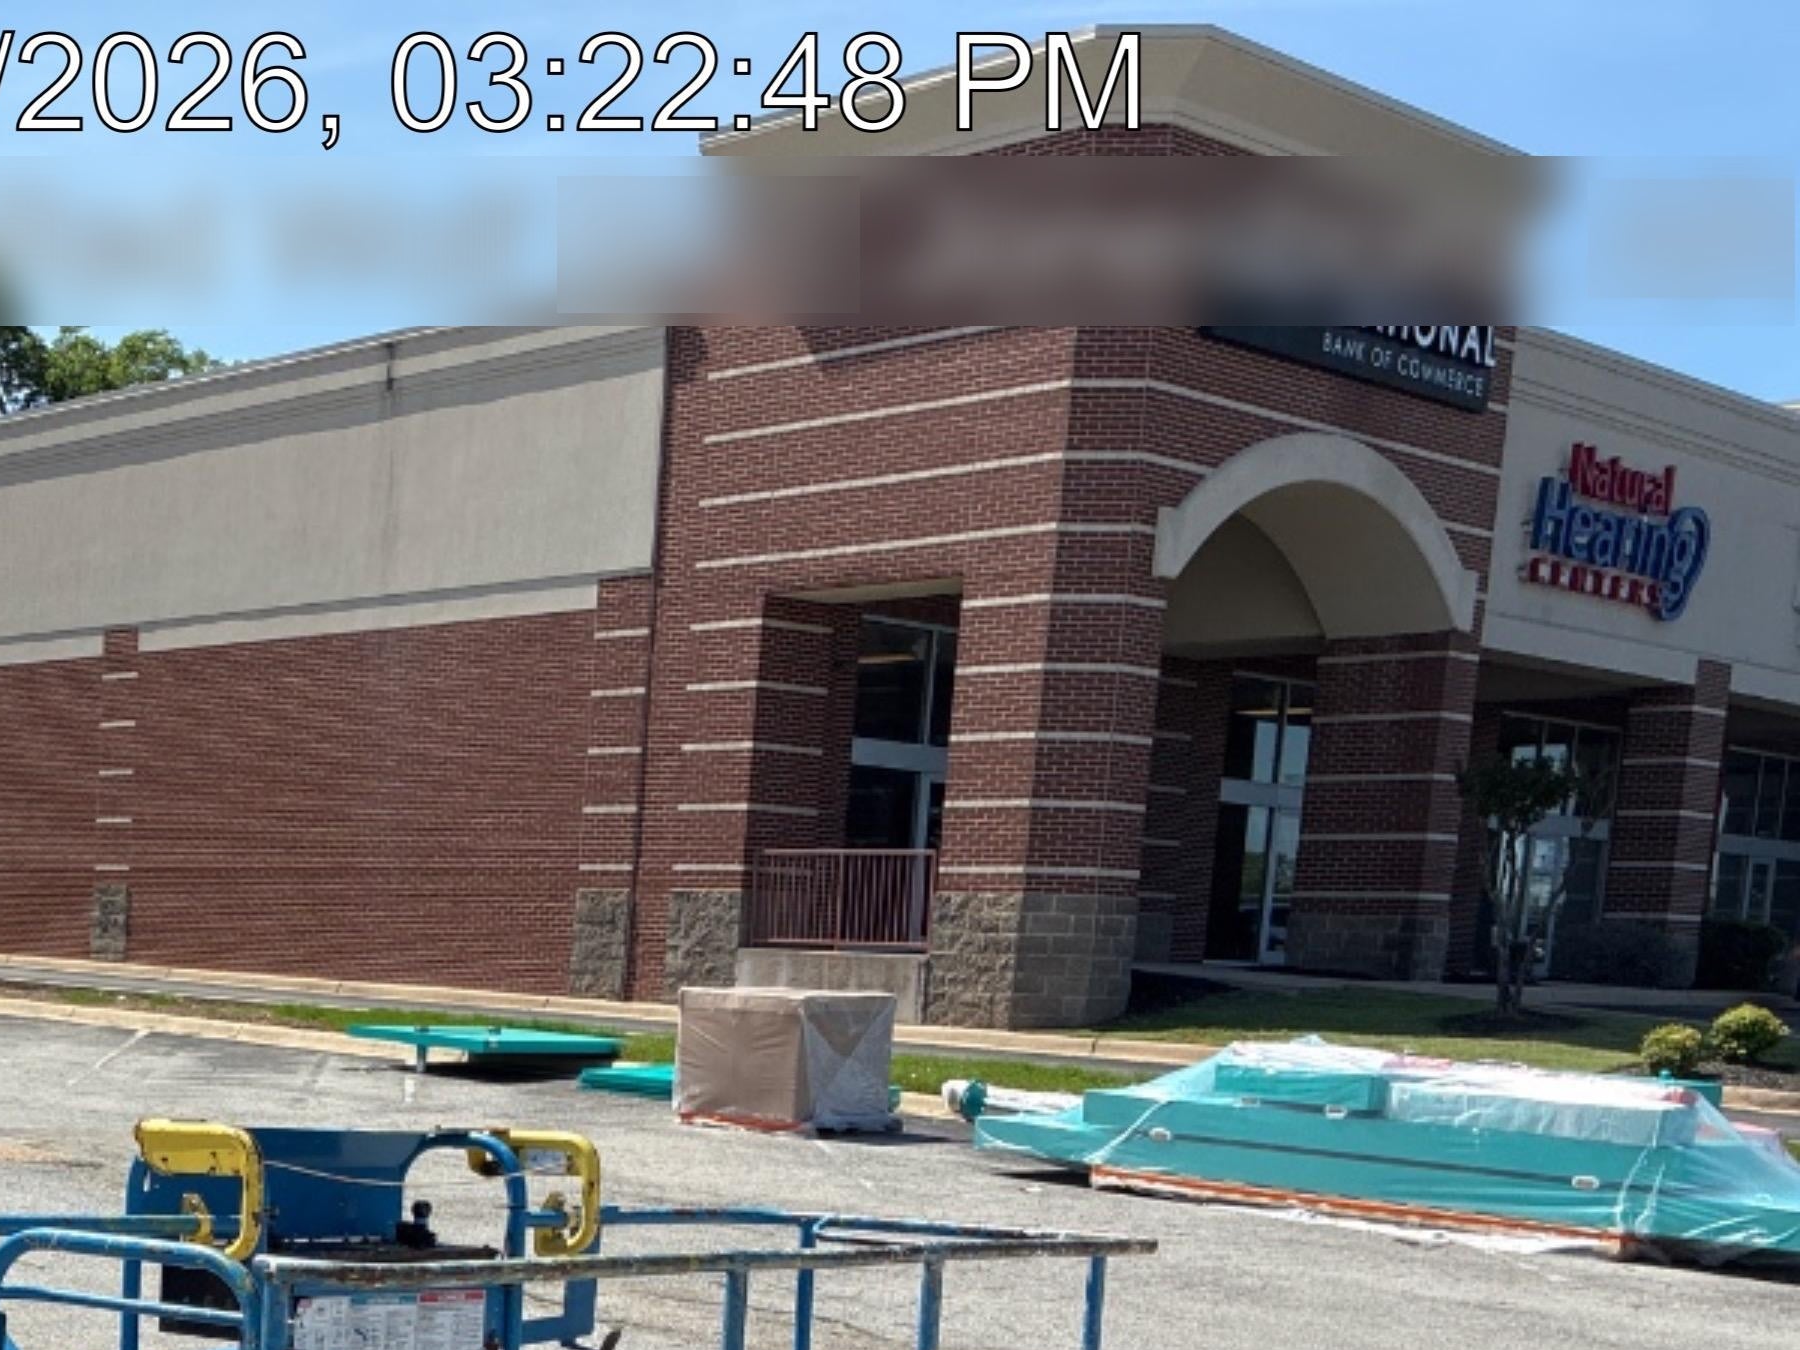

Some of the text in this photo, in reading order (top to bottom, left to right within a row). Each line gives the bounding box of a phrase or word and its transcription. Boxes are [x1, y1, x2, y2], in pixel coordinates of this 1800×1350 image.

[1322, 331, 1484, 397] BANK OF COMMERCE
[1567, 441, 1677, 516] Natural
[1528, 556, 1663, 608] CENTERS
[1529, 476, 1710, 621] Hearing
